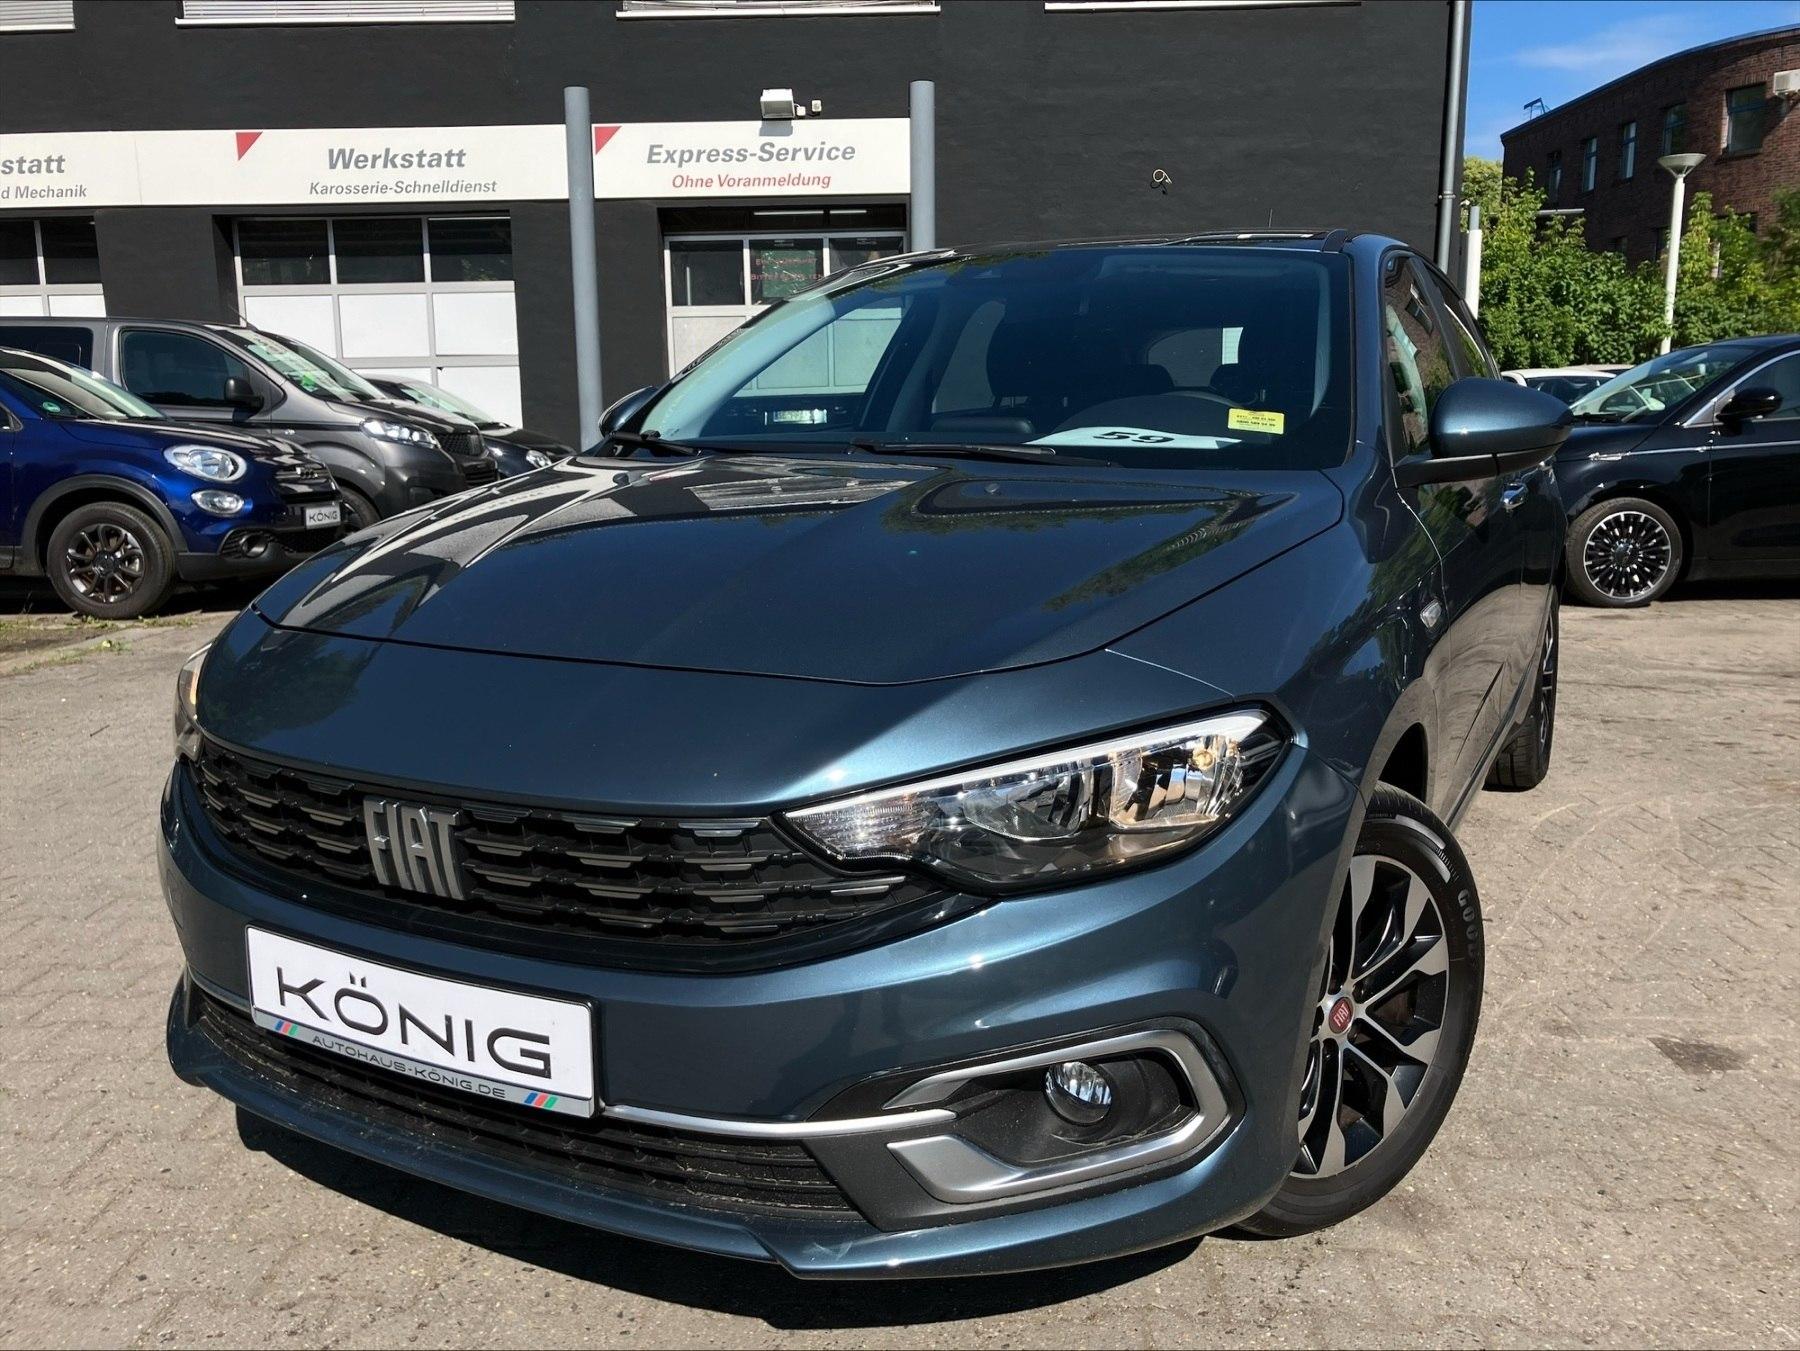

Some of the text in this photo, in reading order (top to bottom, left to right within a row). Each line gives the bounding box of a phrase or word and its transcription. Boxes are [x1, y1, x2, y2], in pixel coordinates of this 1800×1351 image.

[1, 154, 66, 175] statt
[328, 147, 467, 170] Werkstatt
[647, 141, 856, 168] Express-Service
[15, 184, 88, 199] Mechanik
[309, 179, 498, 195] Karosserie-Schnelldienst
[672, 172, 831, 189] Ohne Voranmeldung
[1092, 431, 1175, 444] 59
[309, 509, 338, 522] KÖNIG
[363, 799, 466, 900] FIAT
[276, 966, 553, 1080] KÖNIG
[1333, 1003, 1349, 1027] FIAT
[312, 1035, 506, 1100] AUTOHAUS-KÖNIG.DE
